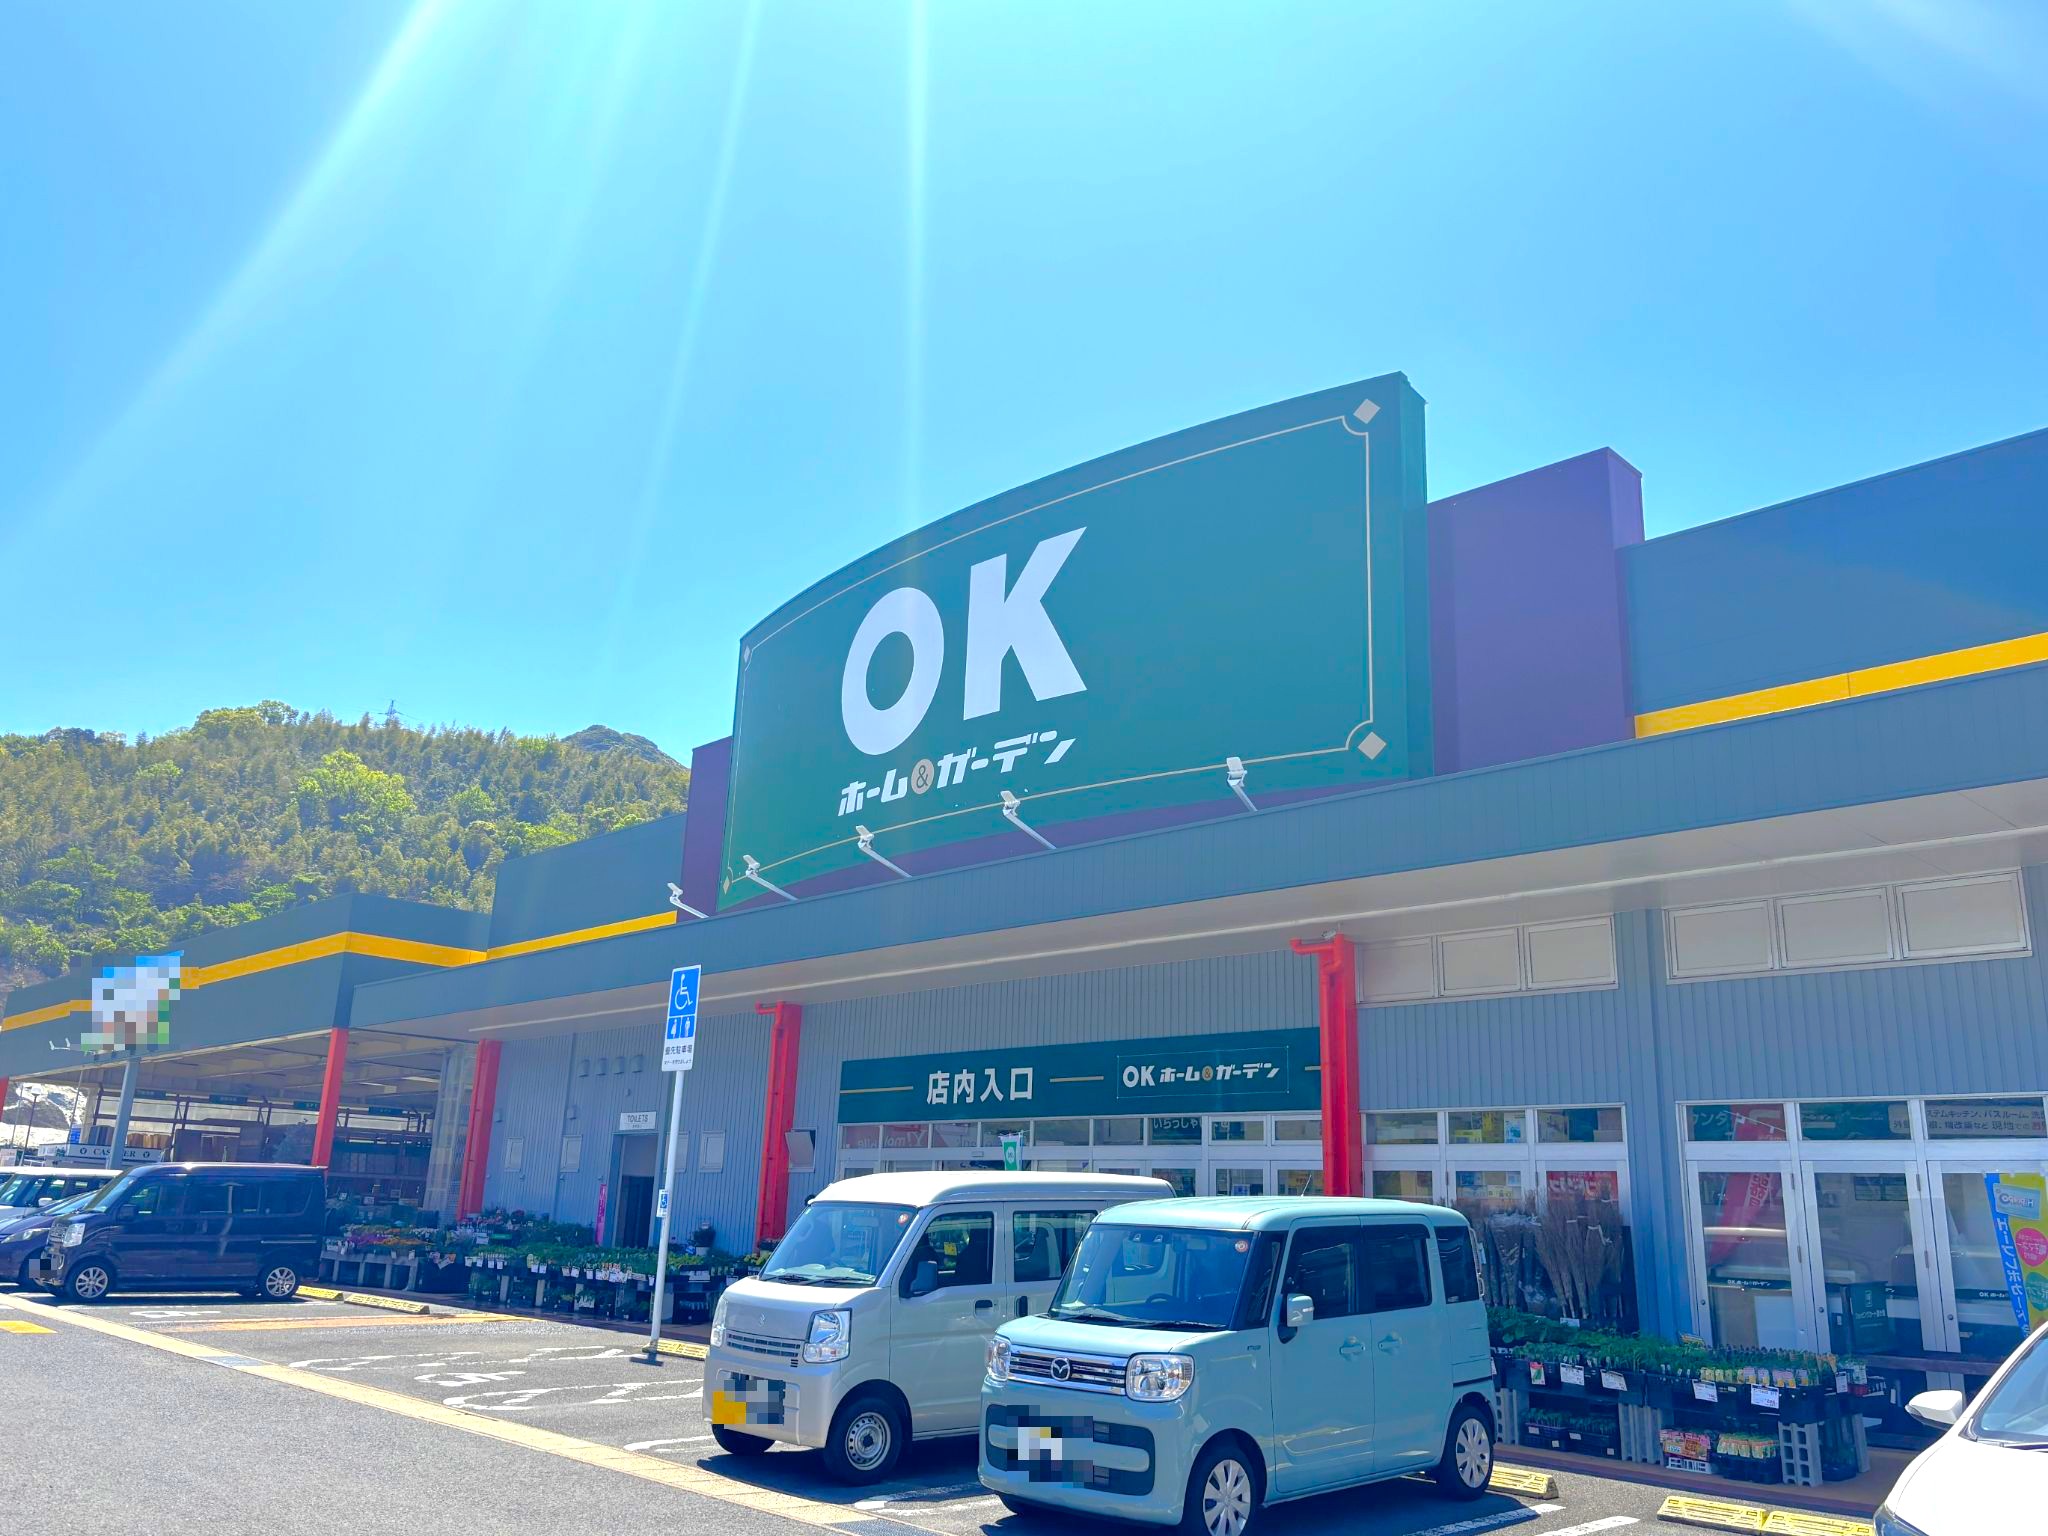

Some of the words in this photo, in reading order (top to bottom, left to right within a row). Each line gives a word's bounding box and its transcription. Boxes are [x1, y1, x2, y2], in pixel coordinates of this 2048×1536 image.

[841, 526, 1087, 756] OK
[837, 730, 1077, 816] ホーム&ガーデン
[926, 1067, 1034, 1105] 店内入口
[1122, 1065, 1156, 1088] OK
[1159, 1062, 1280, 1082] ホーム&ガーデン
[627, 1114, 649, 1123] TOILETS
[93, 1148, 136, 1158] CASER
